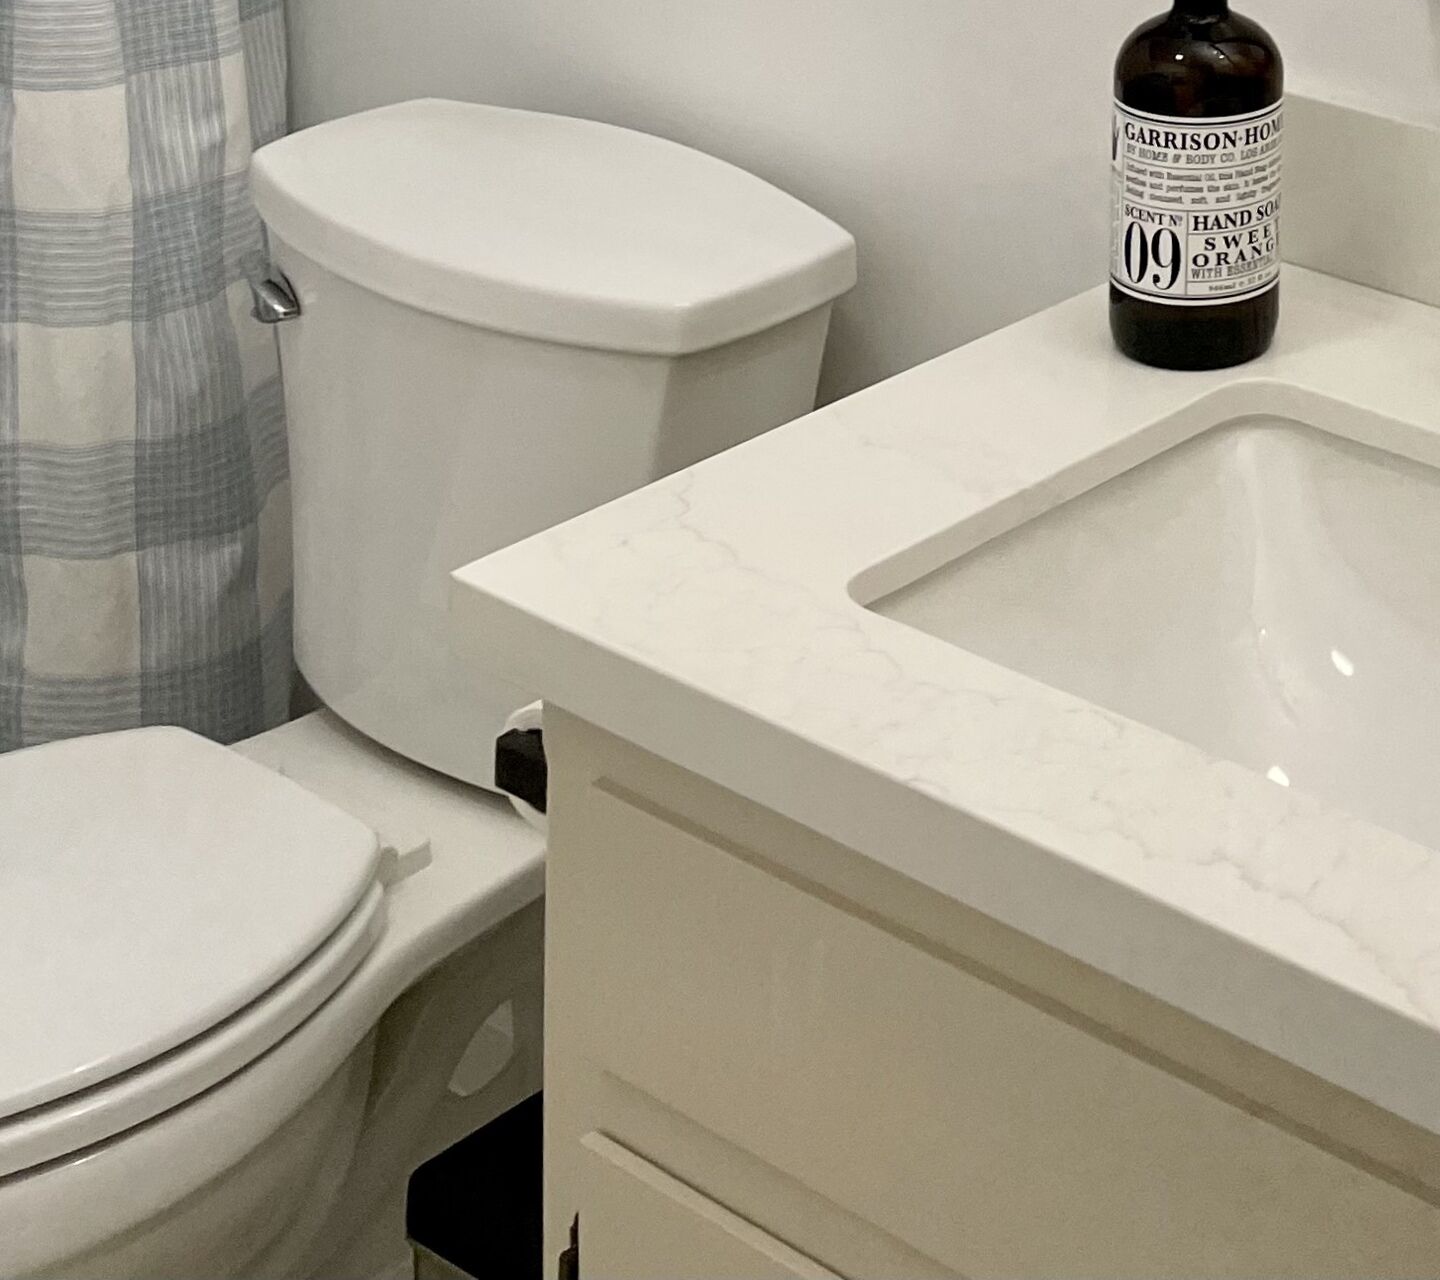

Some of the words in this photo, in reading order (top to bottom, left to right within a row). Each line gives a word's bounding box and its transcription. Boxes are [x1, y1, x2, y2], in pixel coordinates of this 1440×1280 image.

[1139, 147, 1168, 163] HOME
[1186, 153, 1216, 164] BODY
[1125, 204, 1166, 225] SCENT
[1193, 209, 1252, 231] HAND
[1124, 221, 1182, 290] 09
[1191, 267, 1223, 279] WITH
